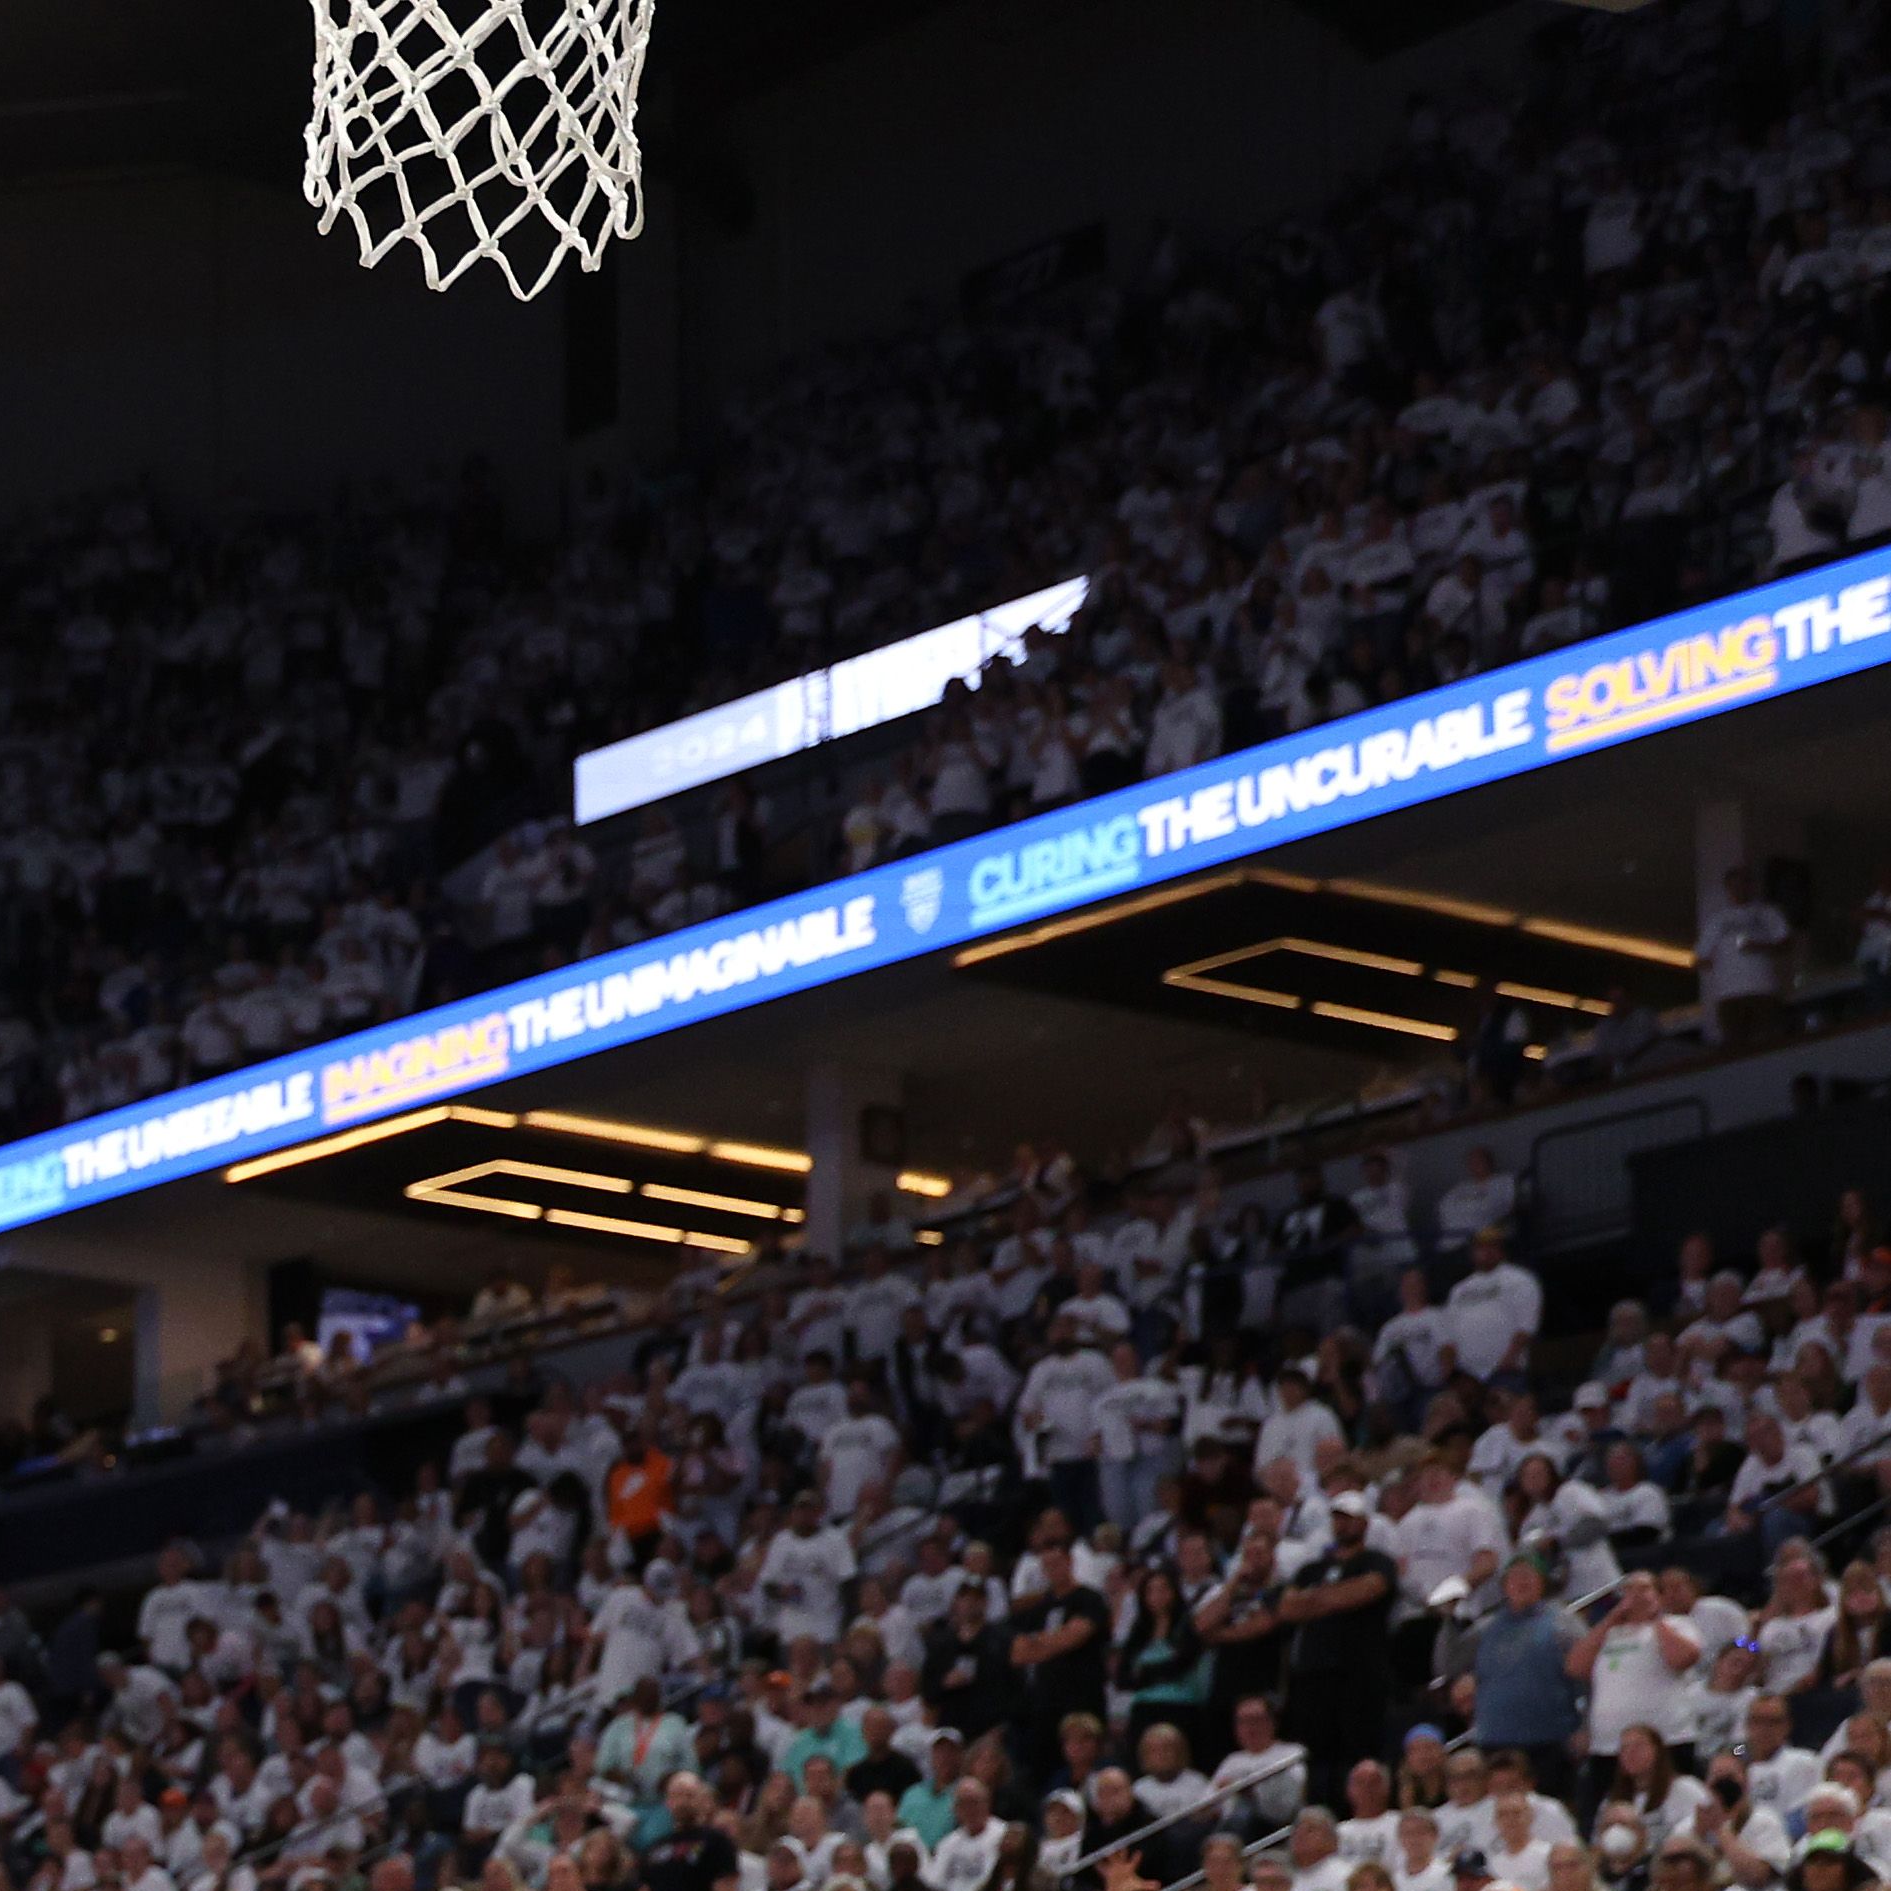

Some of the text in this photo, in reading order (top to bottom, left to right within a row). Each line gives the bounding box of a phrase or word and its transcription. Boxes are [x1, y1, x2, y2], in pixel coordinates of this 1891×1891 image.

[1545, 575, 1891, 729] SOLVING THE
[970, 688, 1534, 903] CURING THE UNCURABLE
[507, 986, 587, 1052] THE
[586, 895, 877, 1028] UNIMAGINABLE
[61, 1136, 132, 1189] THE
